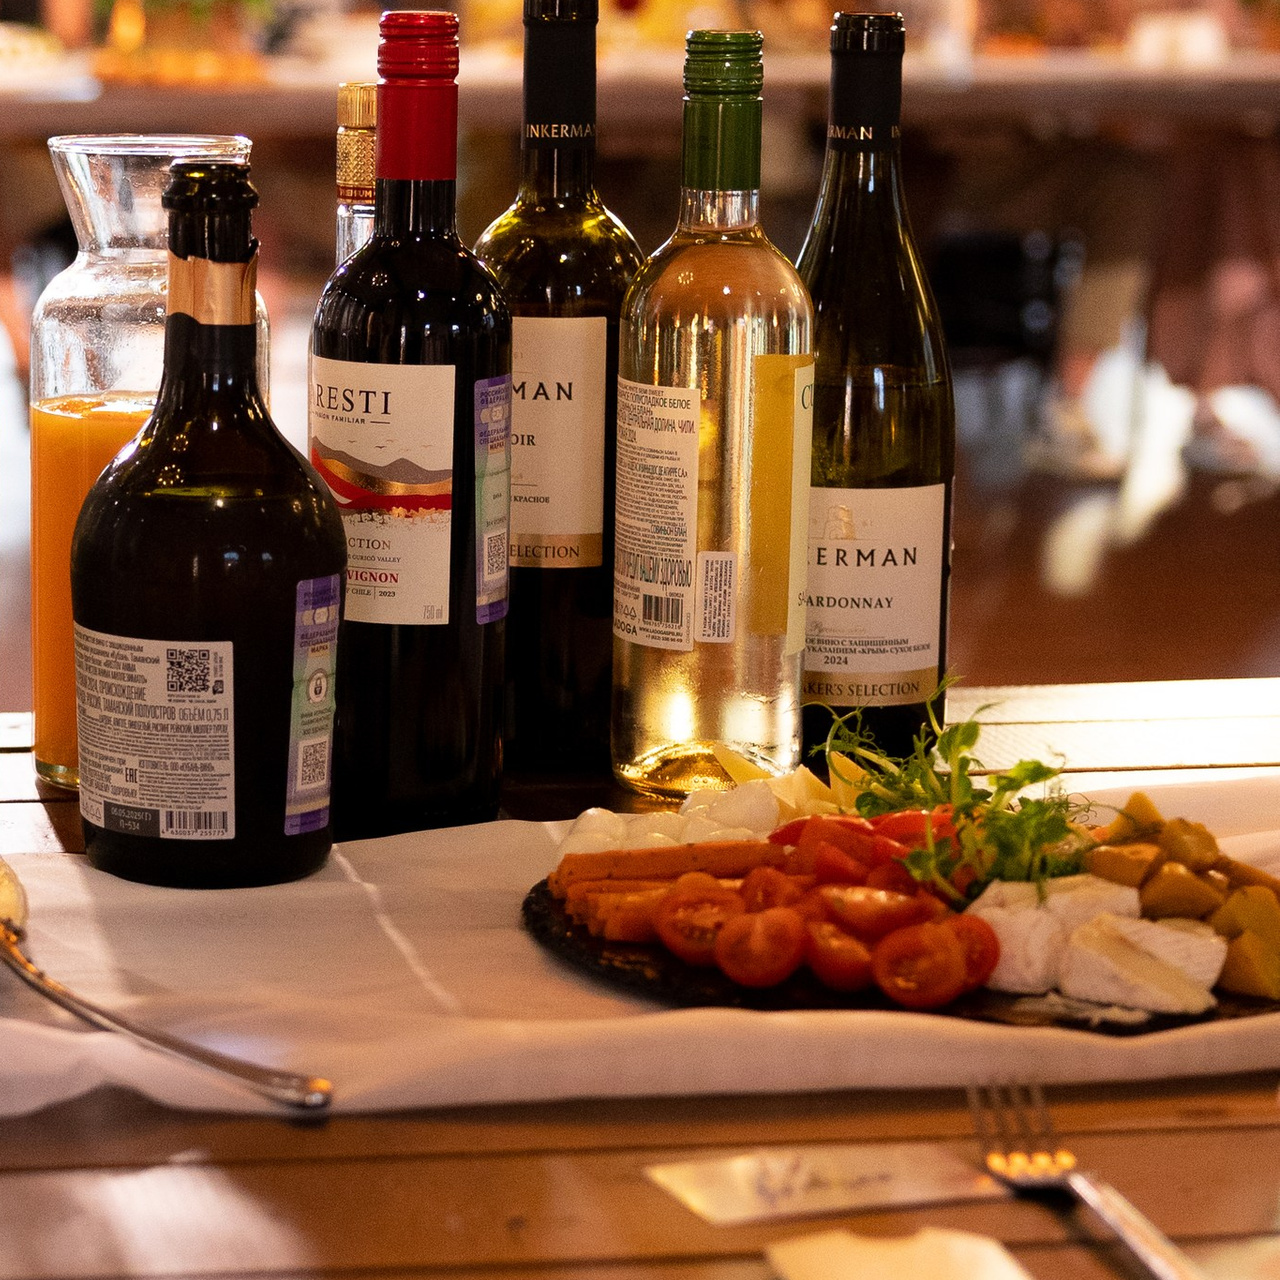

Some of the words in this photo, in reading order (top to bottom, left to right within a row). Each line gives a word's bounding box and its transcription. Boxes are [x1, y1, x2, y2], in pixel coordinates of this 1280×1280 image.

[669, 399, 691, 409] БЕЛОЕ
[332, 415, 365, 424] FAMILIAR
[513, 495, 550, 504] КРАСНОЕ
[348, 537, 391, 550] CTION
[510, 544, 580, 558] ELECTION
[808, 547, 917, 567] ERMAN
[347, 569, 399, 583] VIGNON
[660, 558, 692, 591] ЗДОРОВЬЮ
[806, 596, 893, 609] ARDONNAY
[806, 645, 856, 654] УКАЗАНИЕМ
[857, 647, 889, 655] «КРЫМ»
[823, 655, 848, 665] 2024
[100, 680, 146, 701] ПРОИСХОЖДЕНИЕ
[847, 681, 920, 697] SELECTION
[135, 703, 176, 720] ПОЛУОСТРОВ
[179, 706, 205, 721] ОБЪЁМ
[206, 708, 222, 722] 0,75
